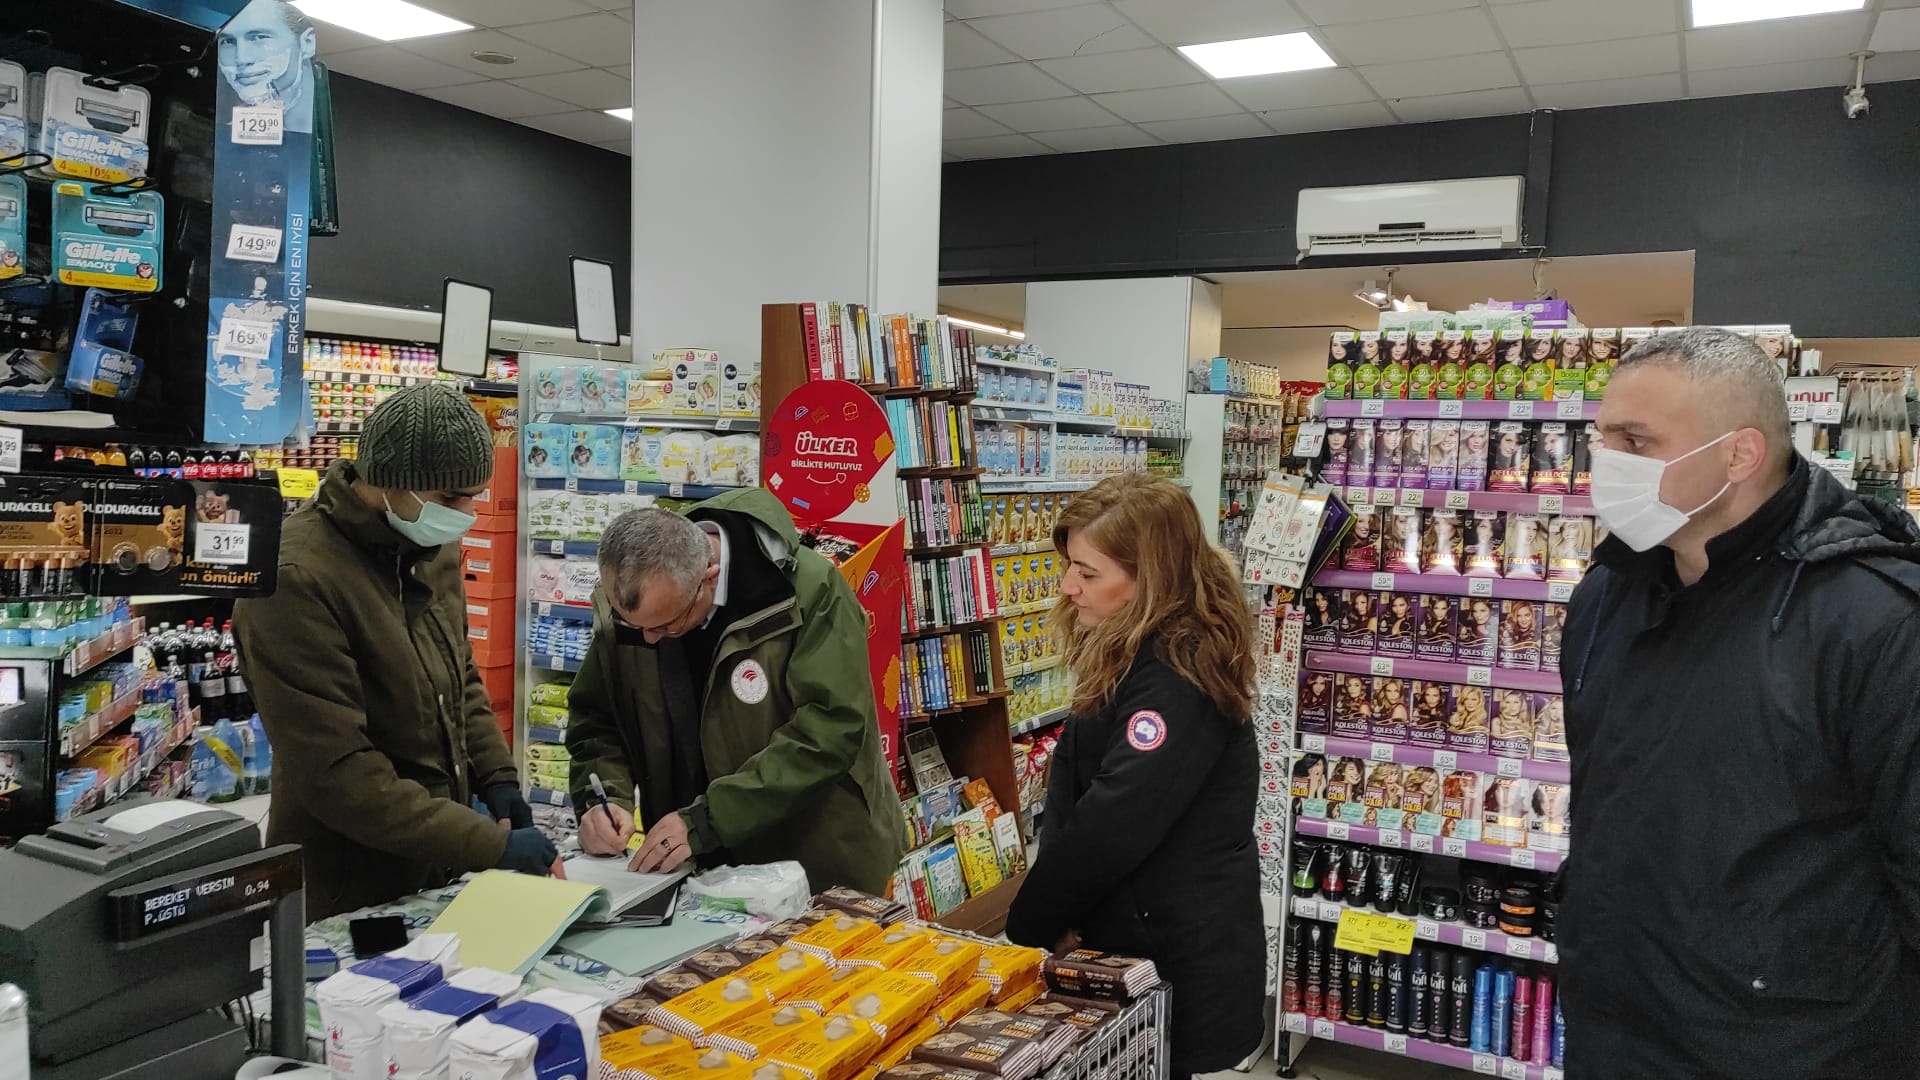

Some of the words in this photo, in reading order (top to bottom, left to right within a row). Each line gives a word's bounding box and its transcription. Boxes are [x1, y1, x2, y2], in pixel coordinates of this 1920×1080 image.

[62, 131, 133, 158] Gillette
[66, 242, 140, 264] Gillette
[292, 248, 301, 268] EN
[288, 304, 300, 354] ERKEK
[795, 430, 858, 456] ÜLKER
[791, 458, 823, 468] BİRLİKTE
[824, 461, 862, 471] MUTLUYUZ
[0, 502, 52, 512] URACELL
[104, 504, 160, 516] DURACELL
[1304, 634, 1336, 642] KOLESTON
[1340, 638, 1374, 646] KOLESTON
[1379, 640, 1412, 650] KOLESTON
[1418, 644, 1453, 653] KOLESTON
[1458, 648, 1494, 657] KOLESTON
[1500, 652, 1538, 662] KOLESTON
[1335, 722, 1368, 731] KOLESTON
[1372, 726, 1406, 736] KOLESTON
[1411, 730, 1446, 740] KOLESTON
[1450, 735, 1487, 745] KOLESTON
[1492, 740, 1528, 750] KOLESTON
[144, 888, 192, 912] BEREKET
[1348, 961, 1362, 974] taft
[1369, 964, 1384, 978] taft
[1388, 968, 1402, 982] taft
[1412, 973, 1428, 986] taft
[1430, 977, 1445, 990] taft
[1452, 980, 1467, 994] taft
